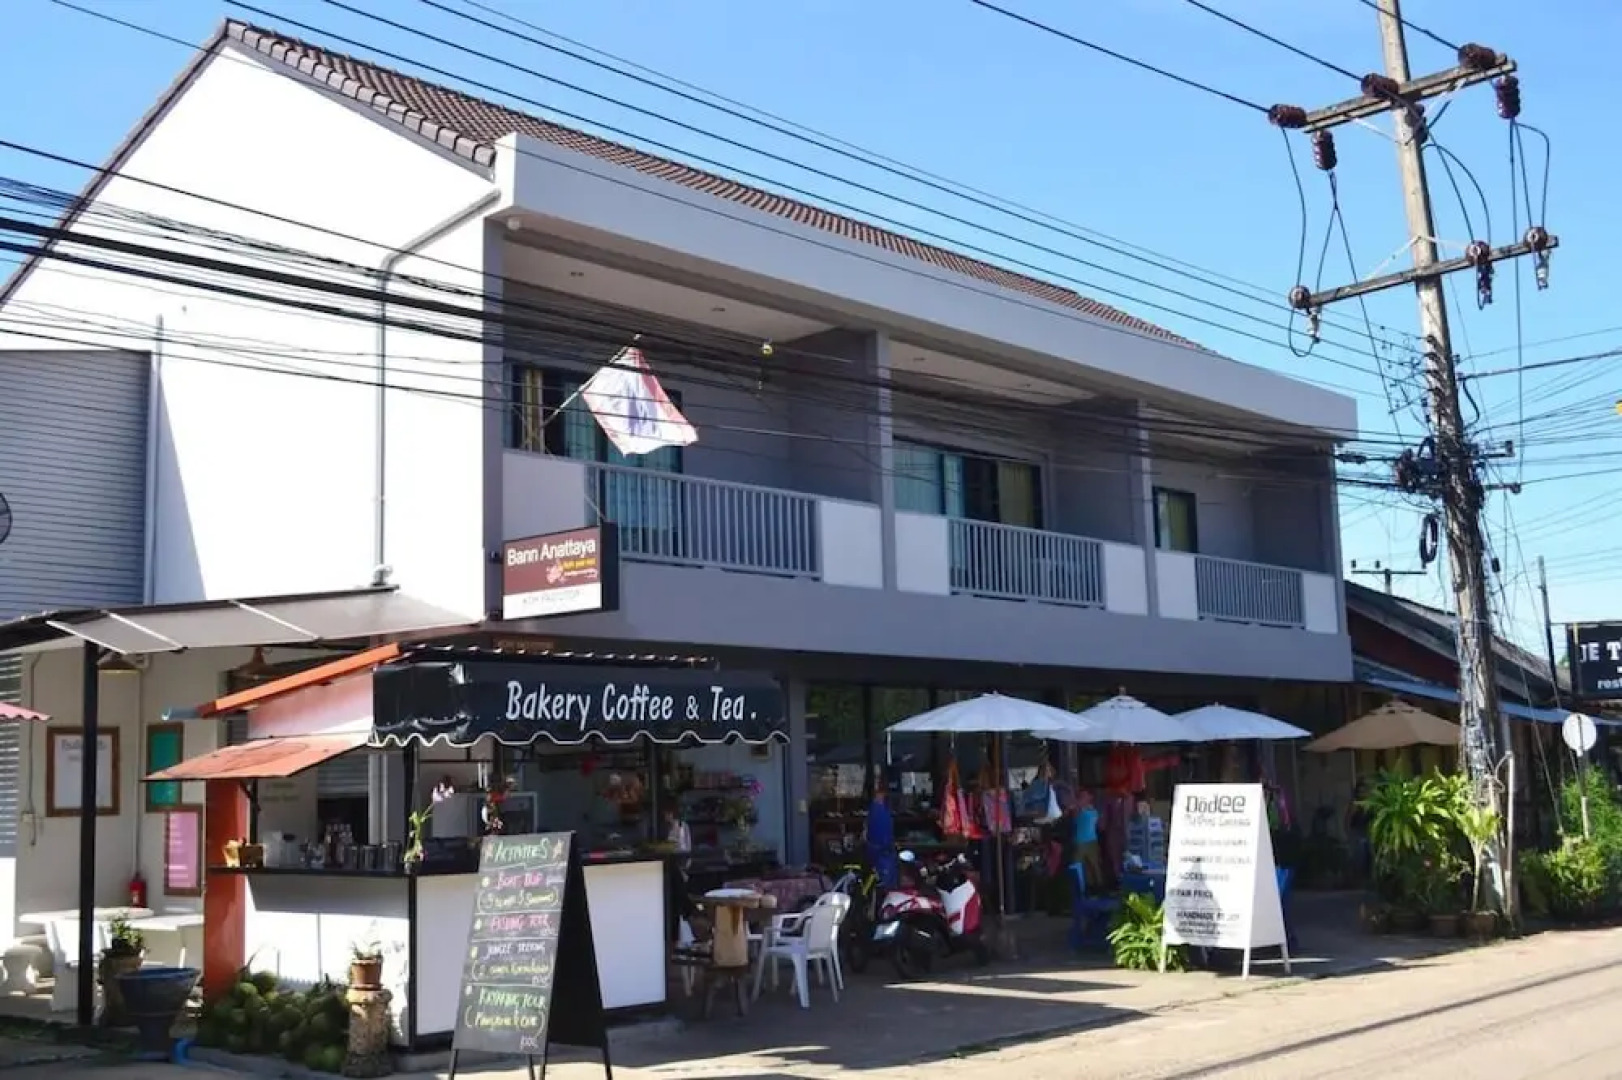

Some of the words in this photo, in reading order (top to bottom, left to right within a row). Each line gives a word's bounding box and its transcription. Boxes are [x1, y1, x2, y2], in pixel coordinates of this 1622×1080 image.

[507, 548, 539, 566] Bann
[540, 539, 596, 560] Anattaya
[1579, 642, 1600, 663] JE
[505, 680, 591, 730] Bakery
[602, 683, 673, 722] Coffee
[685, 695, 700, 720] &
